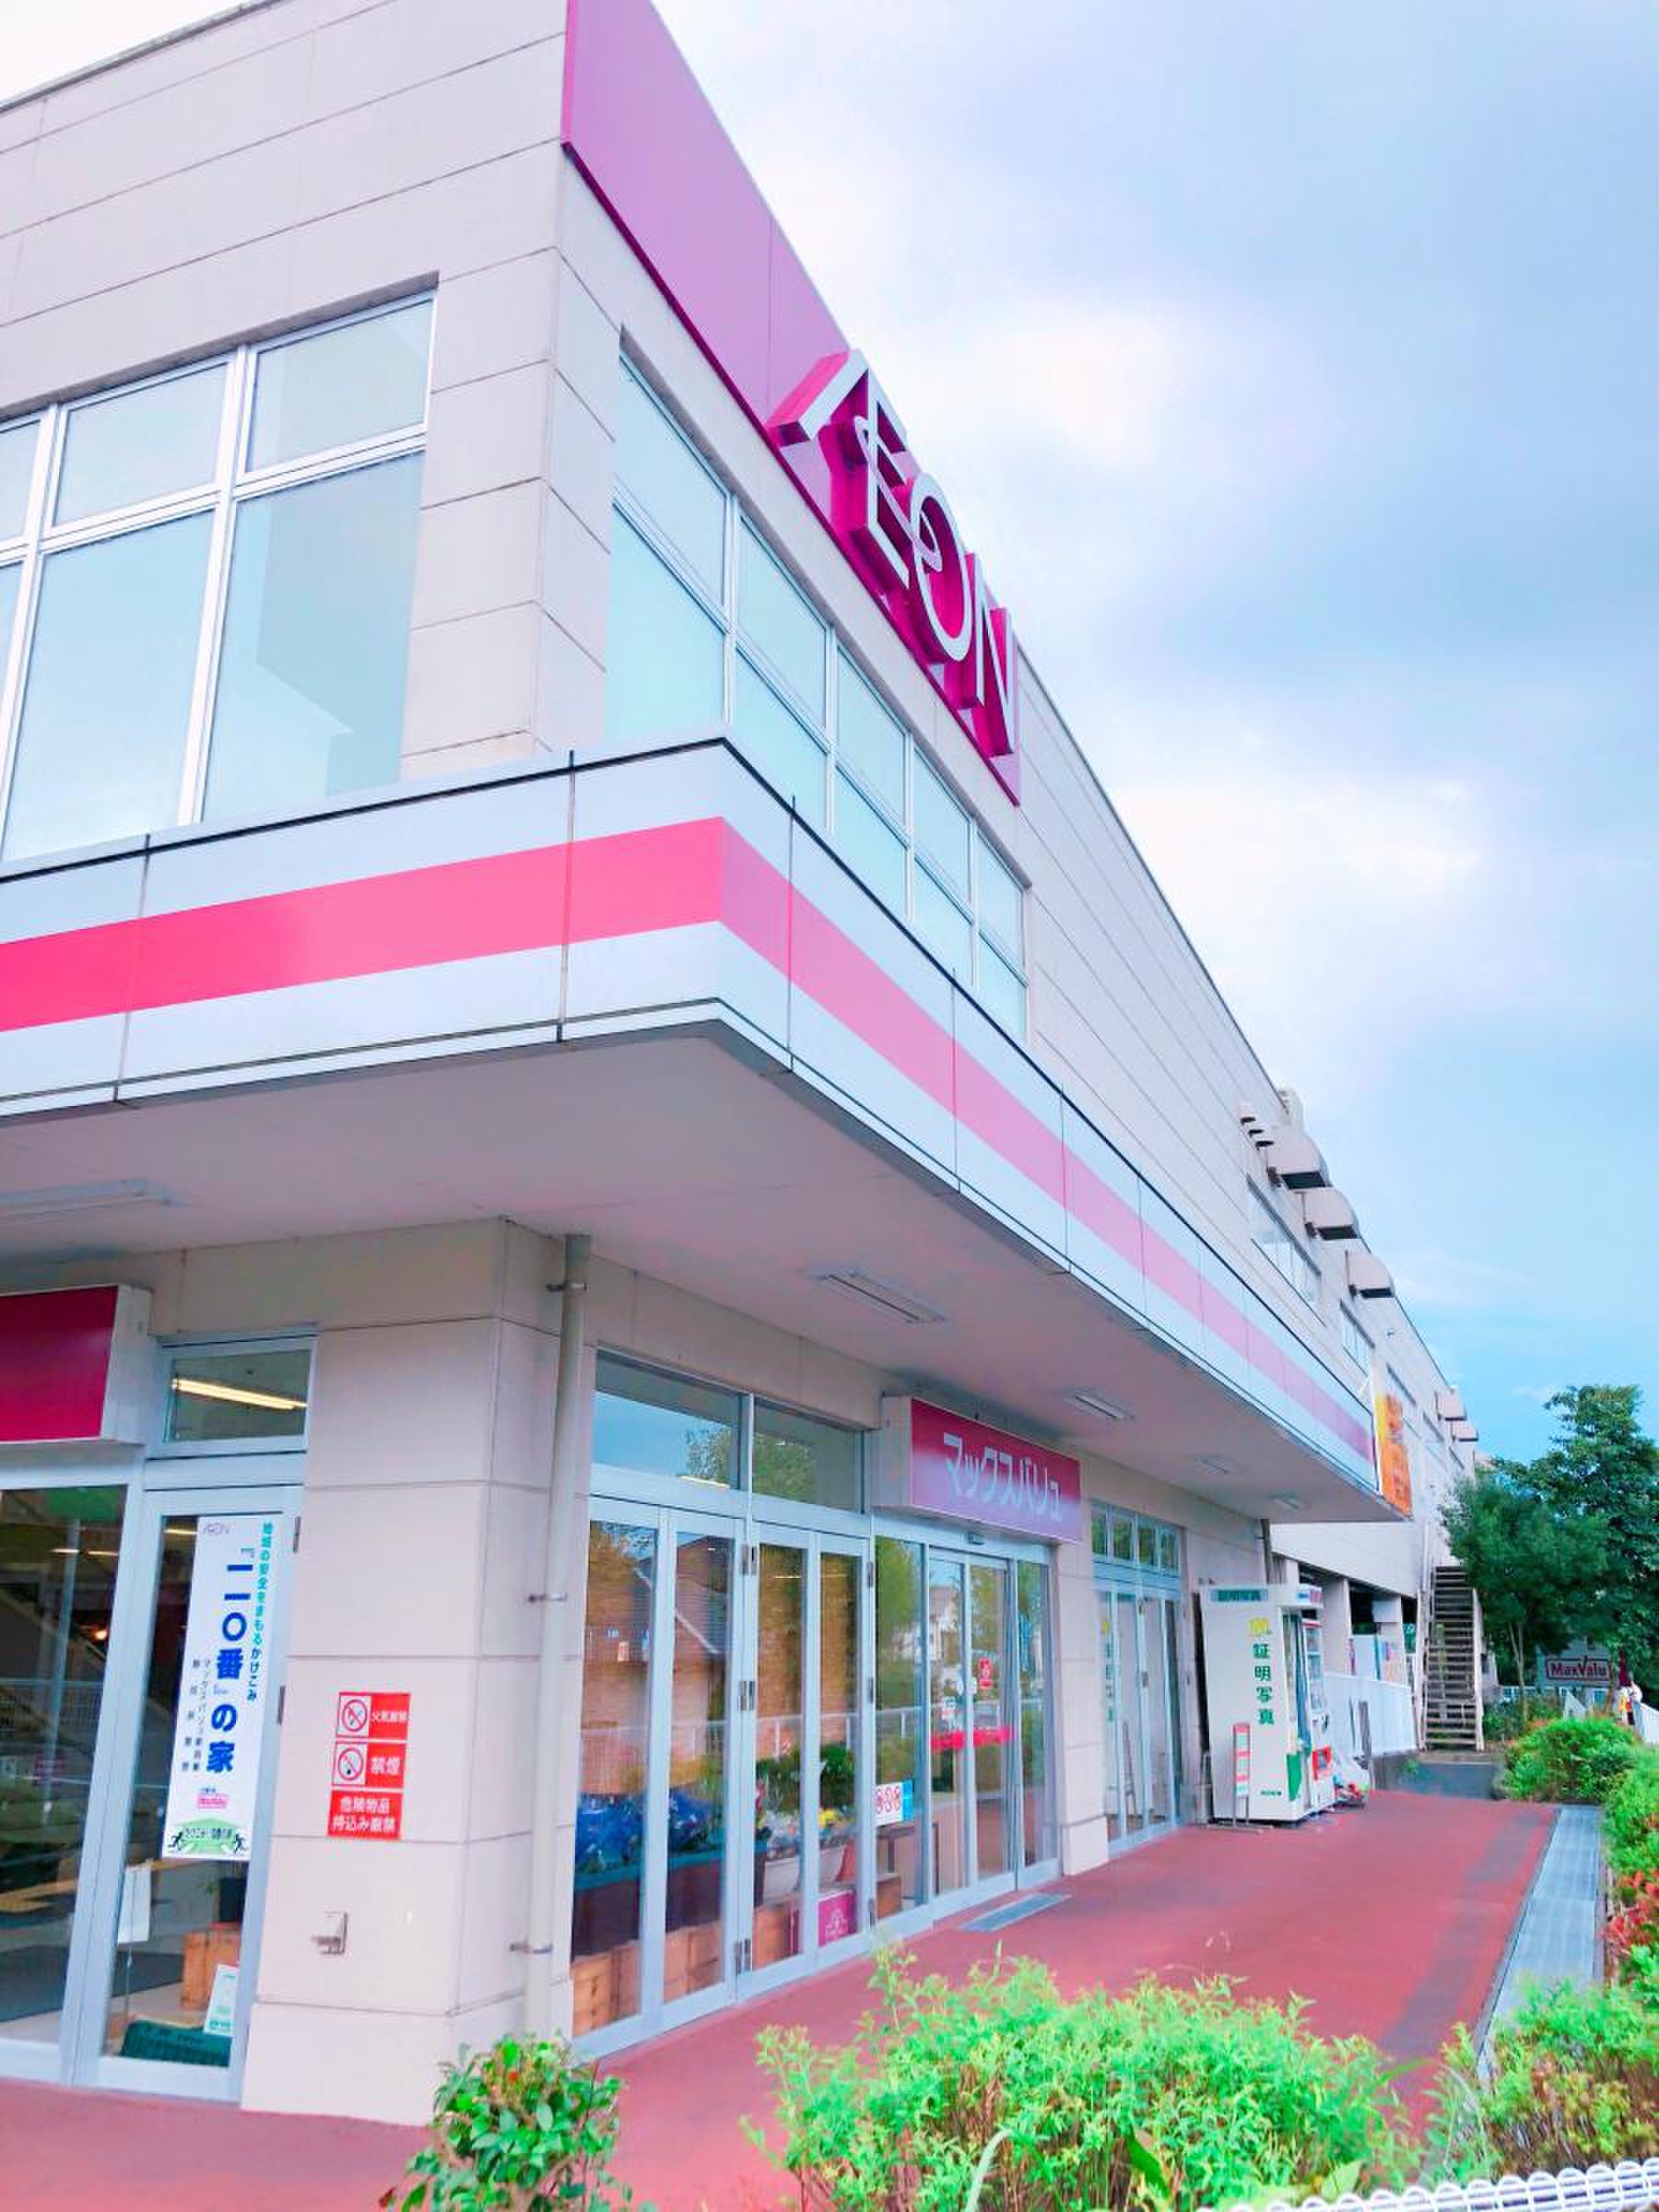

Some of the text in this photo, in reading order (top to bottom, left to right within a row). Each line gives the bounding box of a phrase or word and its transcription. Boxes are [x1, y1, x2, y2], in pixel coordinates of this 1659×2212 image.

[767, 347, 1014, 758] AEON
[943, 1431, 1062, 1522] マックスバリュ
[1253, 1643, 1275, 1725] 証明写真
[371, 1757, 401, 1775] 禁煙
